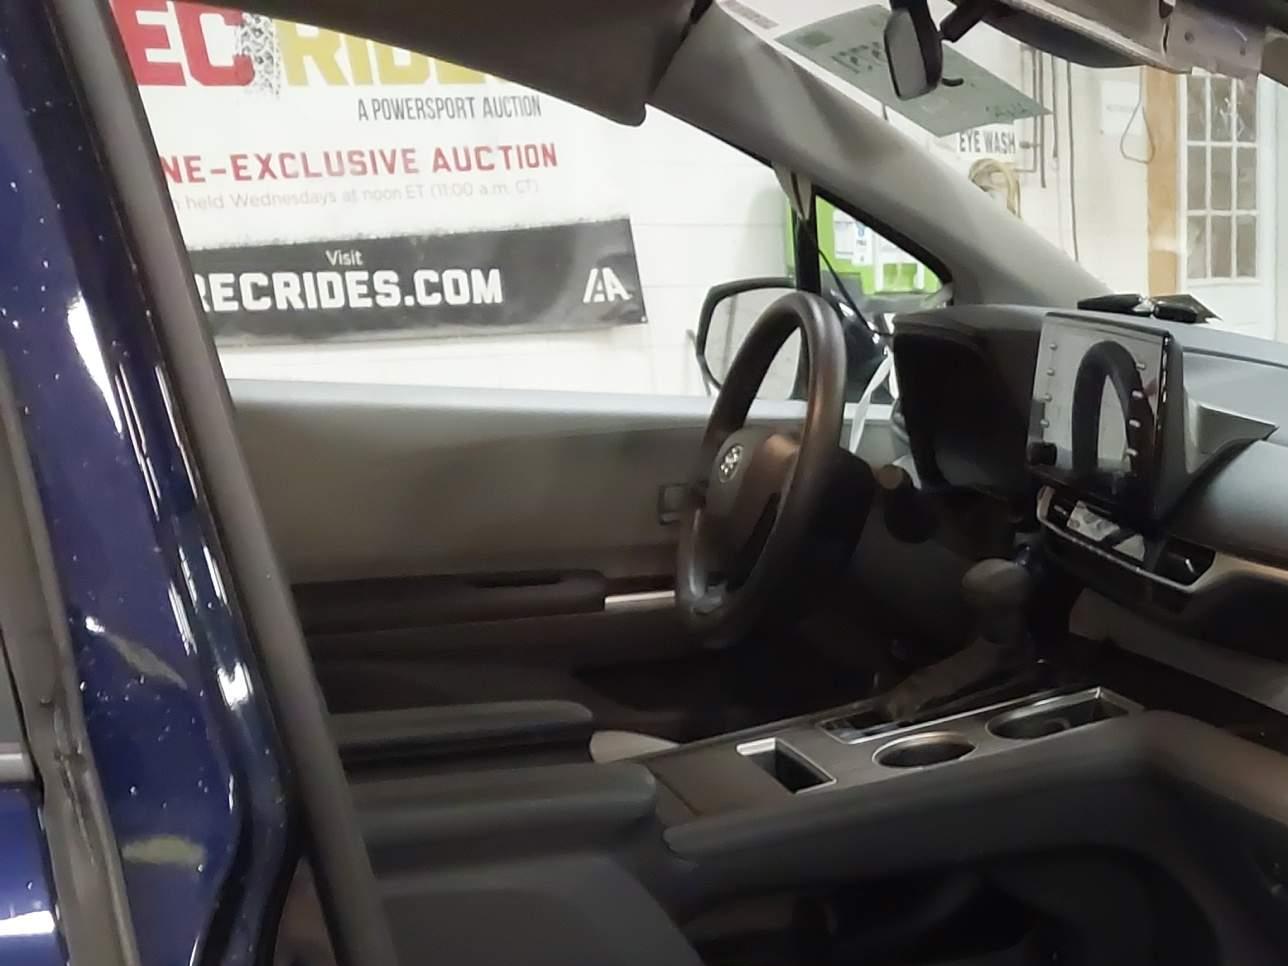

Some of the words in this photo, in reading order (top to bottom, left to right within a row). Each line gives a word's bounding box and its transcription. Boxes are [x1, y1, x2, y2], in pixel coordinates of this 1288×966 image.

[358, 99, 369, 121] A
[372, 97, 475, 120] POWERSPORT
[482, 95, 542, 119] AUCTION
[960, 129, 981, 153] EYE
[984, 131, 1016, 154] WASH
[432, 142, 557, 173] AUCTION
[187, 194, 225, 211] held
[229, 190, 337, 209] Wednesdays
[342, 187, 360, 203] at
[363, 188, 402, 202] noon
[406, 184, 424, 199] ET
[326, 250, 364, 266] Visit
